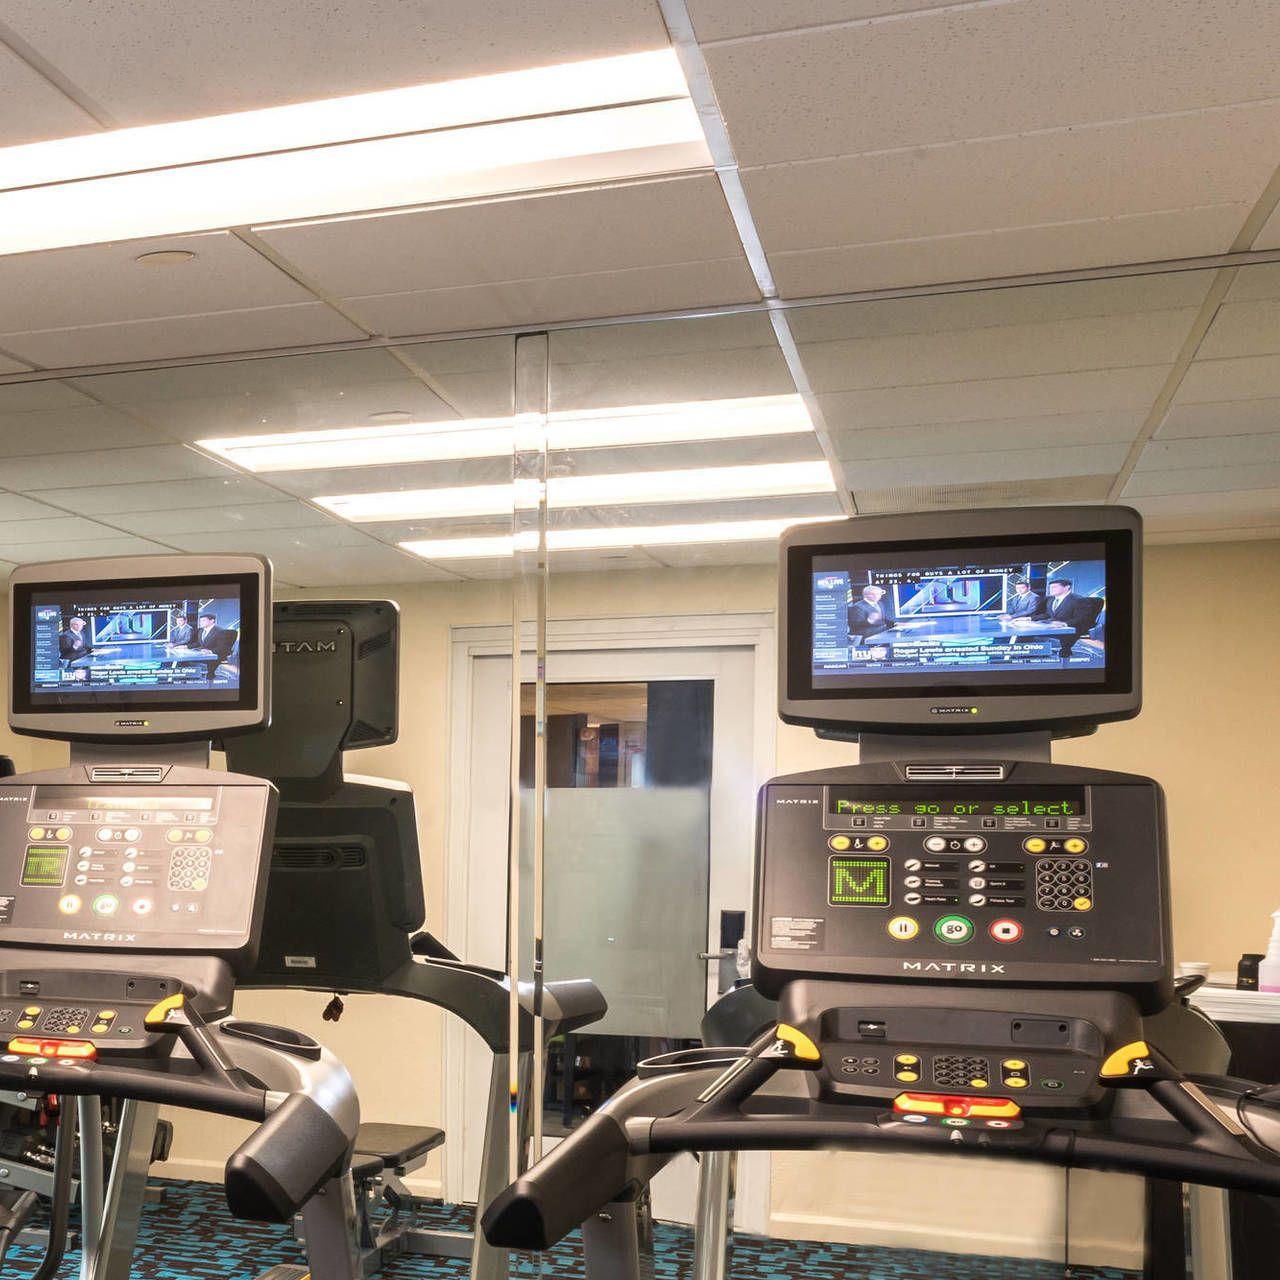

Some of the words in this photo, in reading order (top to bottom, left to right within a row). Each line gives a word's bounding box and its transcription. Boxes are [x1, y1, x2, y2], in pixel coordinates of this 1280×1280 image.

[837, 800, 901, 814] Press
[914, 803, 940, 815] go
[953, 804, 979, 815] or
[993, 801, 1074, 815] select
[836, 869, 883, 894] M
[946, 924, 962, 934] go
[63, 932, 136, 942] MATRIX
[903, 962, 1006, 973] MATRIX
